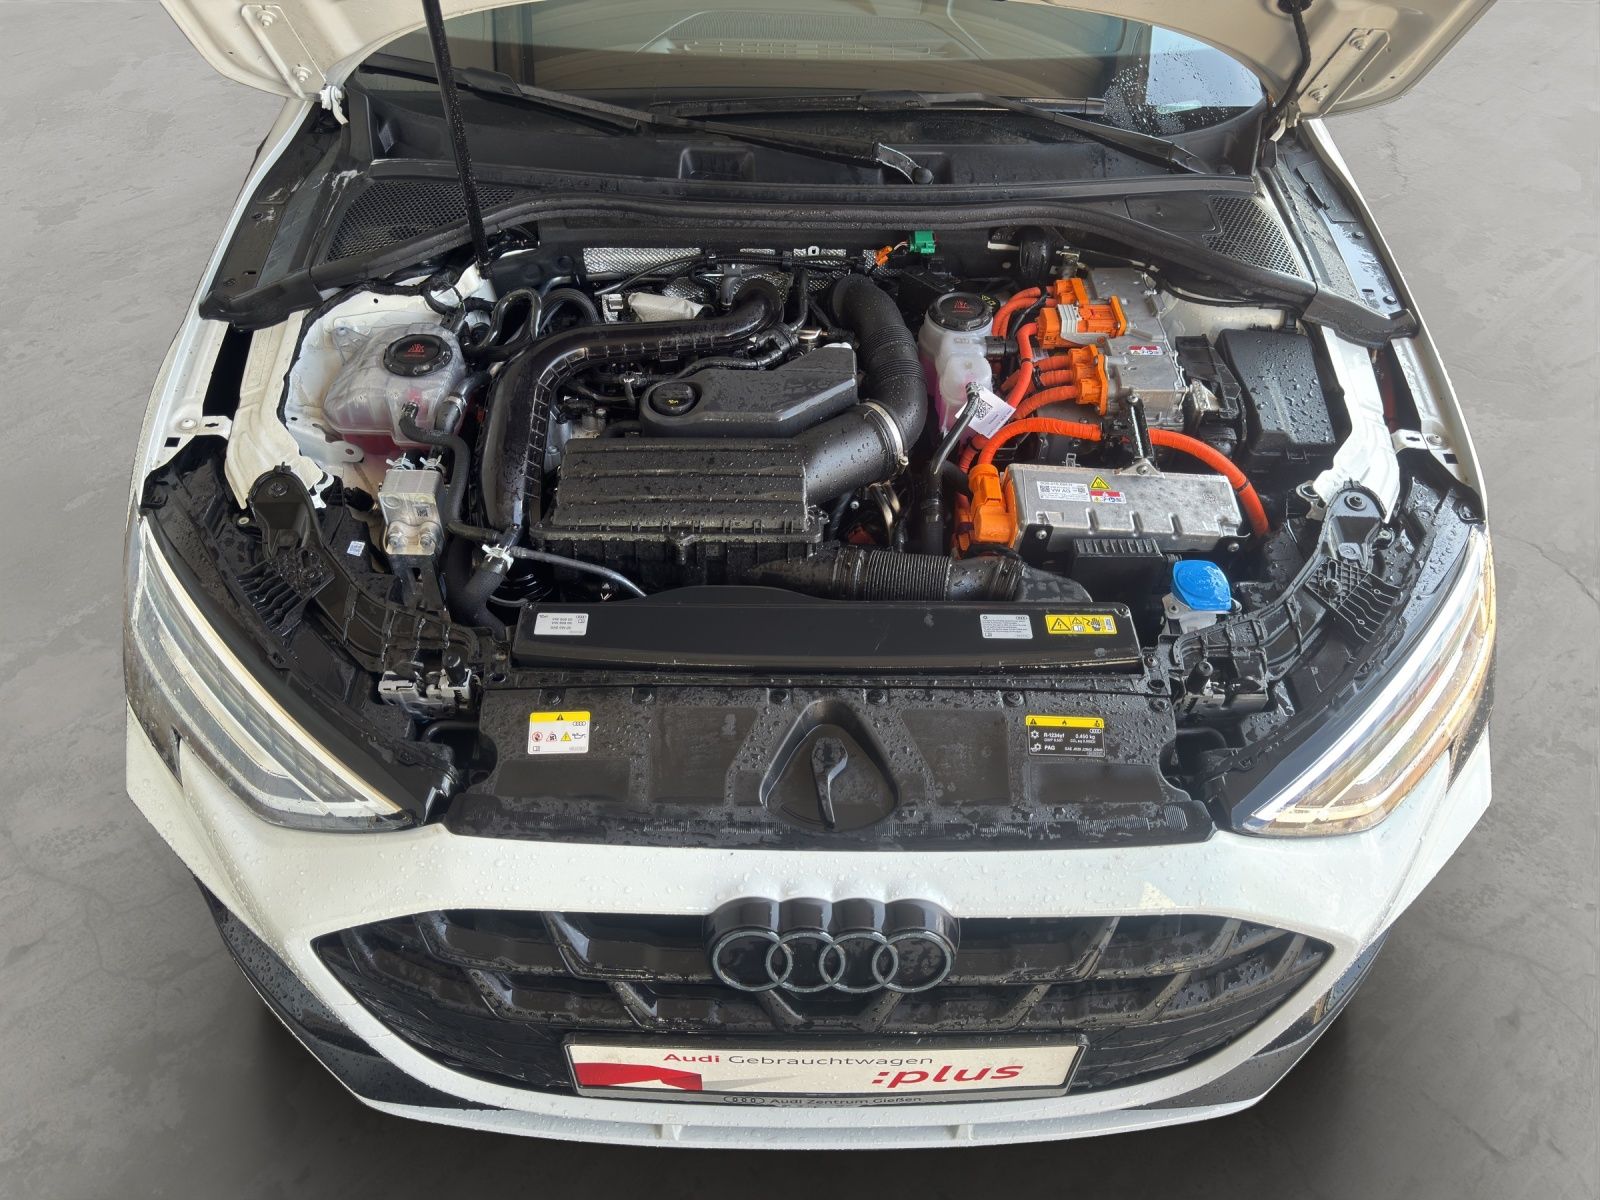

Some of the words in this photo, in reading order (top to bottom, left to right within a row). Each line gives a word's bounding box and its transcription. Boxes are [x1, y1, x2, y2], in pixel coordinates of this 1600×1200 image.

[663, 1053, 720, 1063] Audi
[729, 1055, 933, 1066] Gebrauchtwagen
[872, 1065, 1024, 1088] :plus
